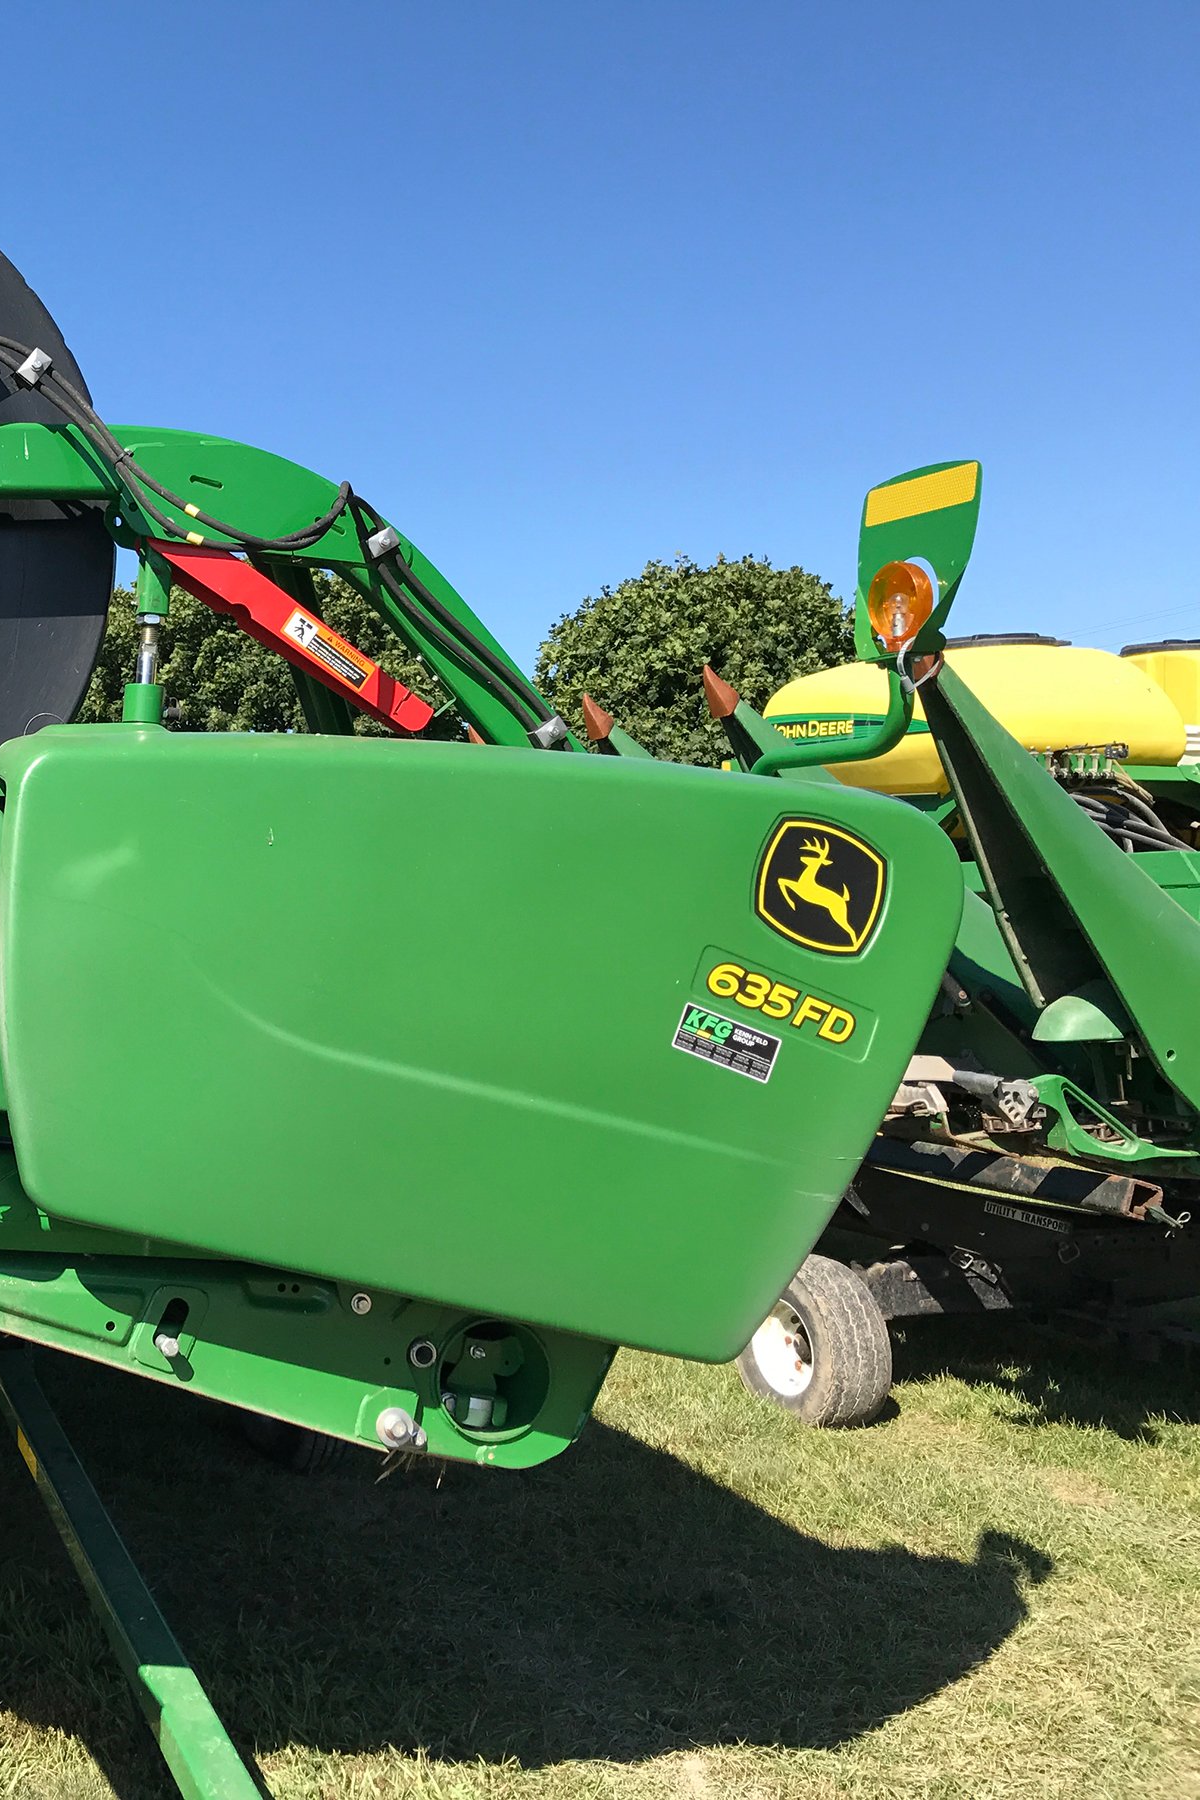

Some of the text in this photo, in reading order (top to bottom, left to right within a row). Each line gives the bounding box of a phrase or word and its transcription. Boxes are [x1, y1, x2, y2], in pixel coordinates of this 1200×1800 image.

[335, 640, 365, 667] WARNING
[807, 720, 854, 737] DEERE
[684, 1008, 734, 1039] KFG
[732, 1034, 755, 1047] GROUP
[986, 1202, 1016, 1218] UTILITY
